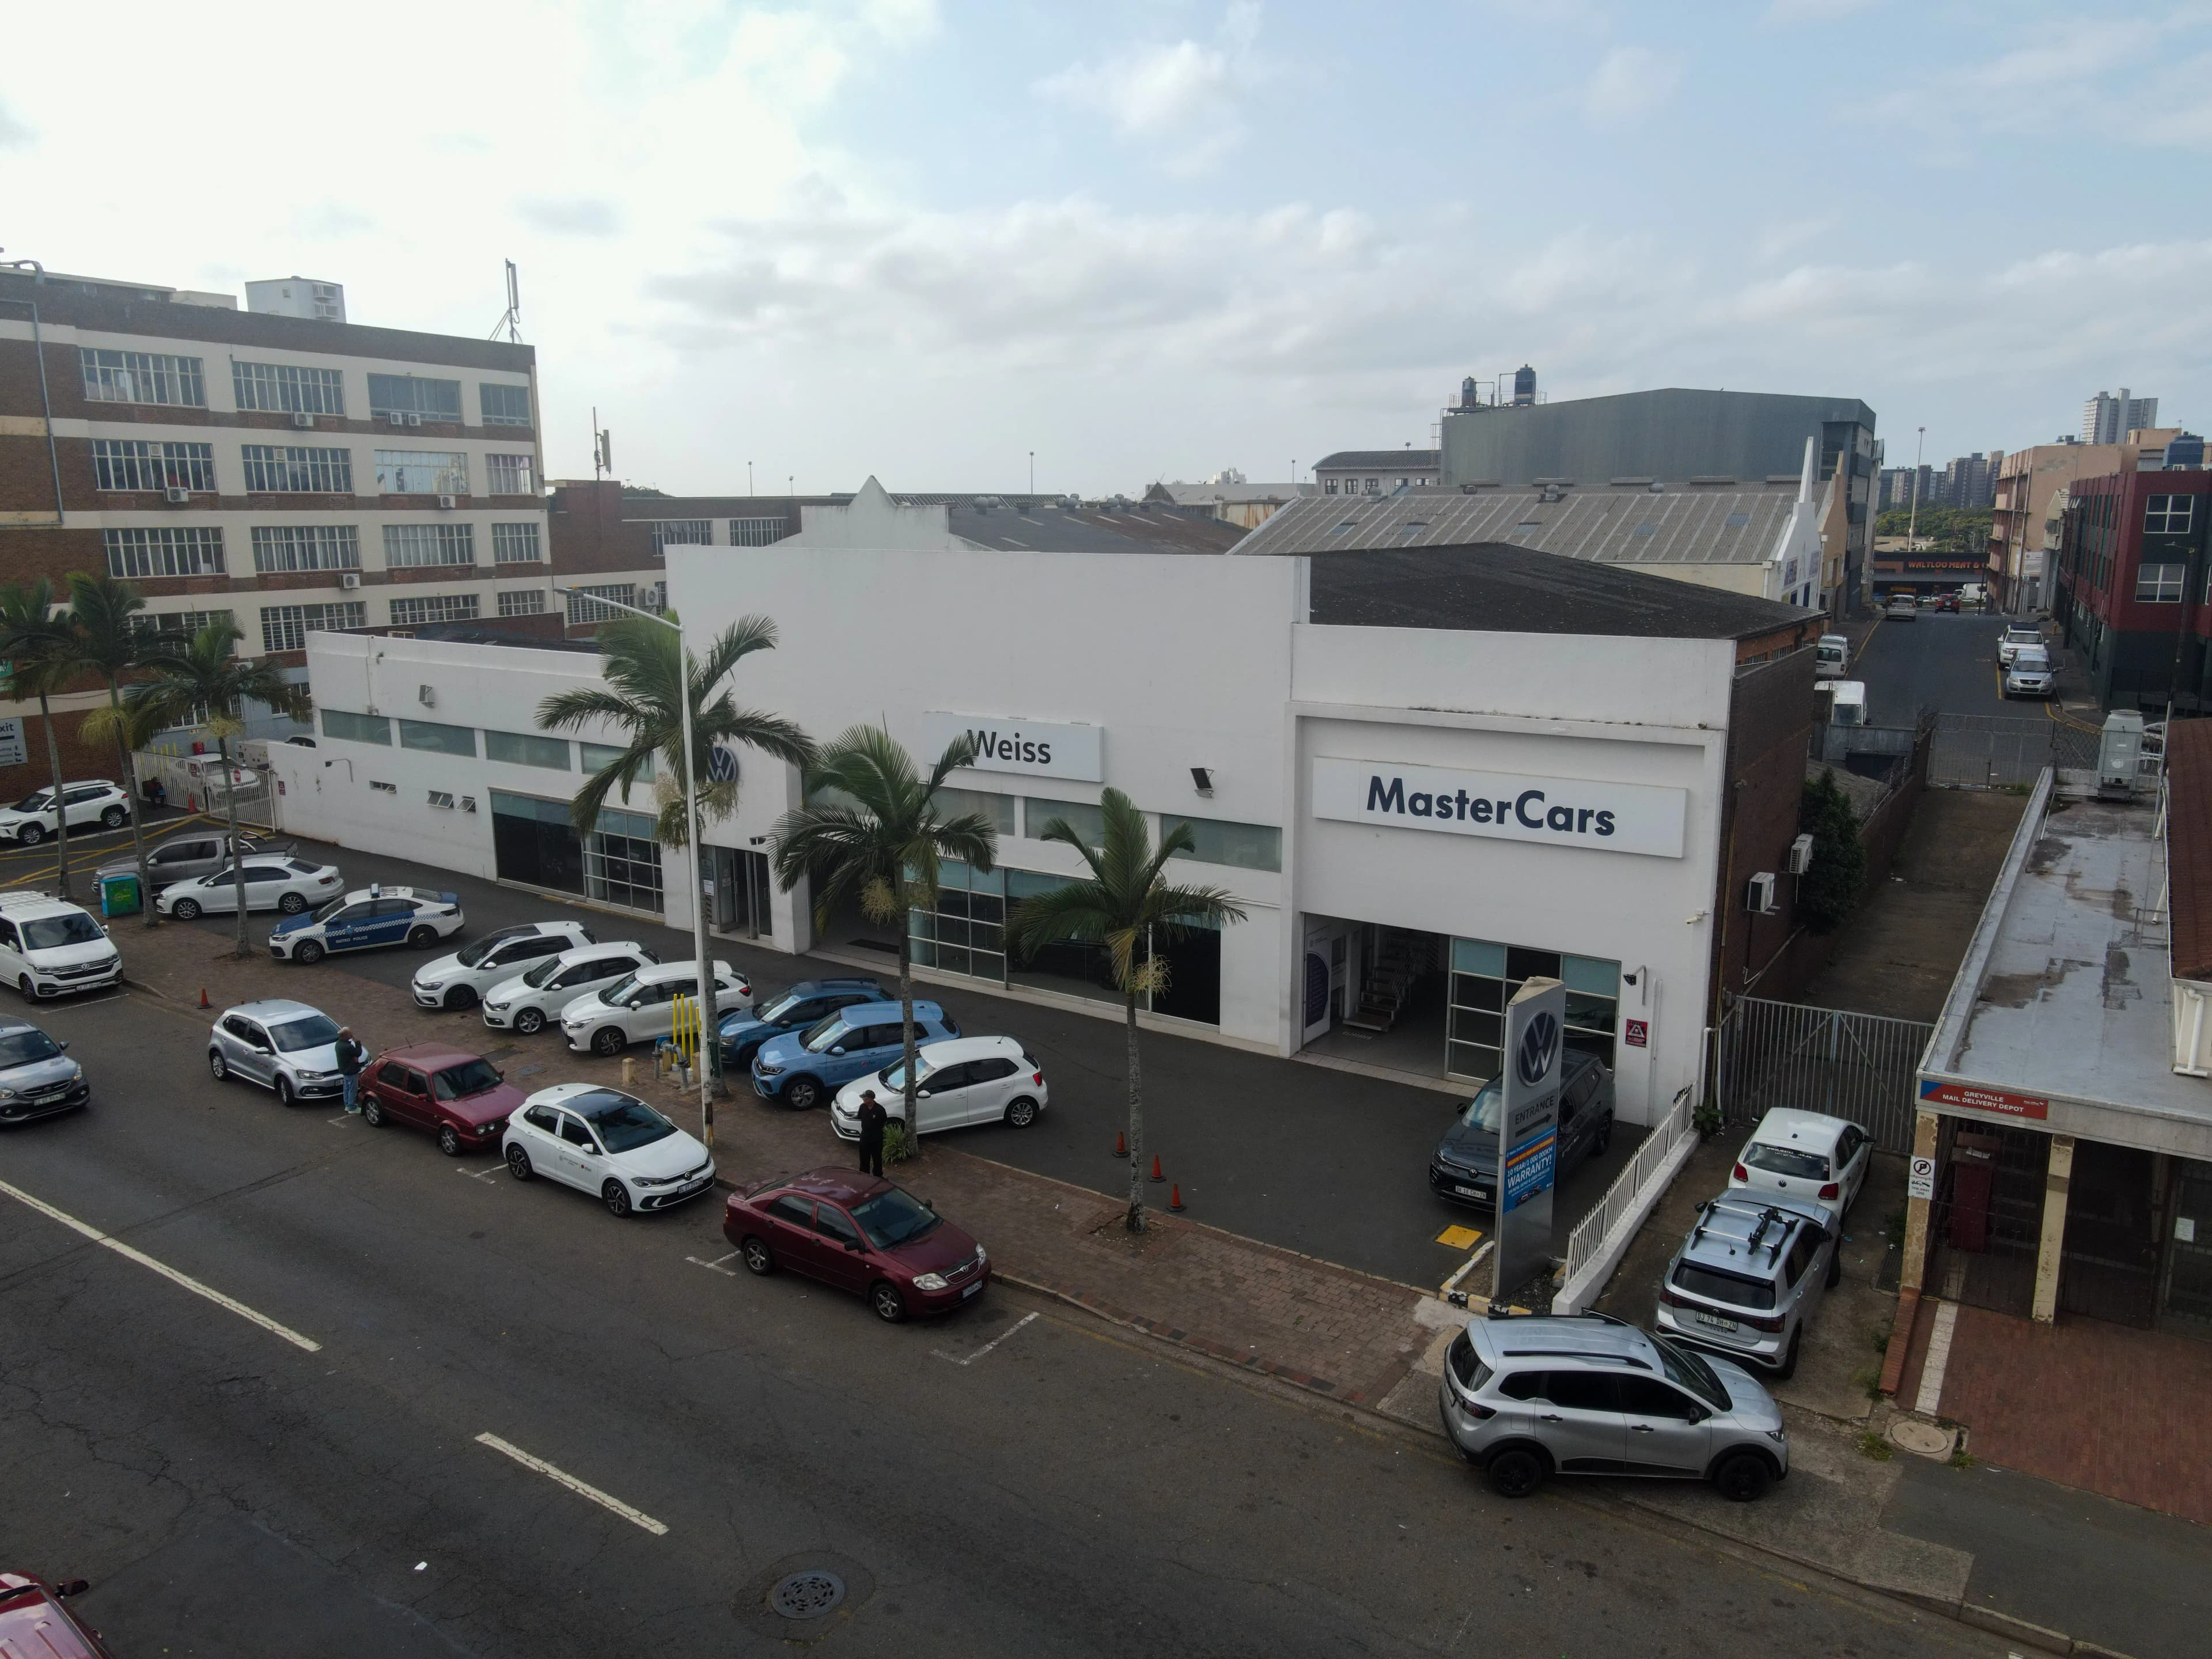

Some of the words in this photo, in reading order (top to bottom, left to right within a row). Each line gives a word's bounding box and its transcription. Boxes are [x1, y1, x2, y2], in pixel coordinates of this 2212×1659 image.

[0, 722, 14, 732] xit
[967, 729, 1051, 764] Weiss
[1366, 775, 1615, 836] MasterCars
[1516, 1096, 1554, 1125] ENTRANCE
[1942, 1094, 1960, 1102] MAIL
[1962, 1097, 1997, 1108] DELIVERY
[1999, 1104, 2024, 1112] DEPOT
[1964, 1091, 2004, 1103] GREYVILLE
[1508, 1154, 1552, 1188] WARRANTY!
[1514, 1159, 1529, 1173] YEAR/1
[1530, 1154, 1538, 1164] 000
[1539, 1146, 1552, 1158] 000KM
